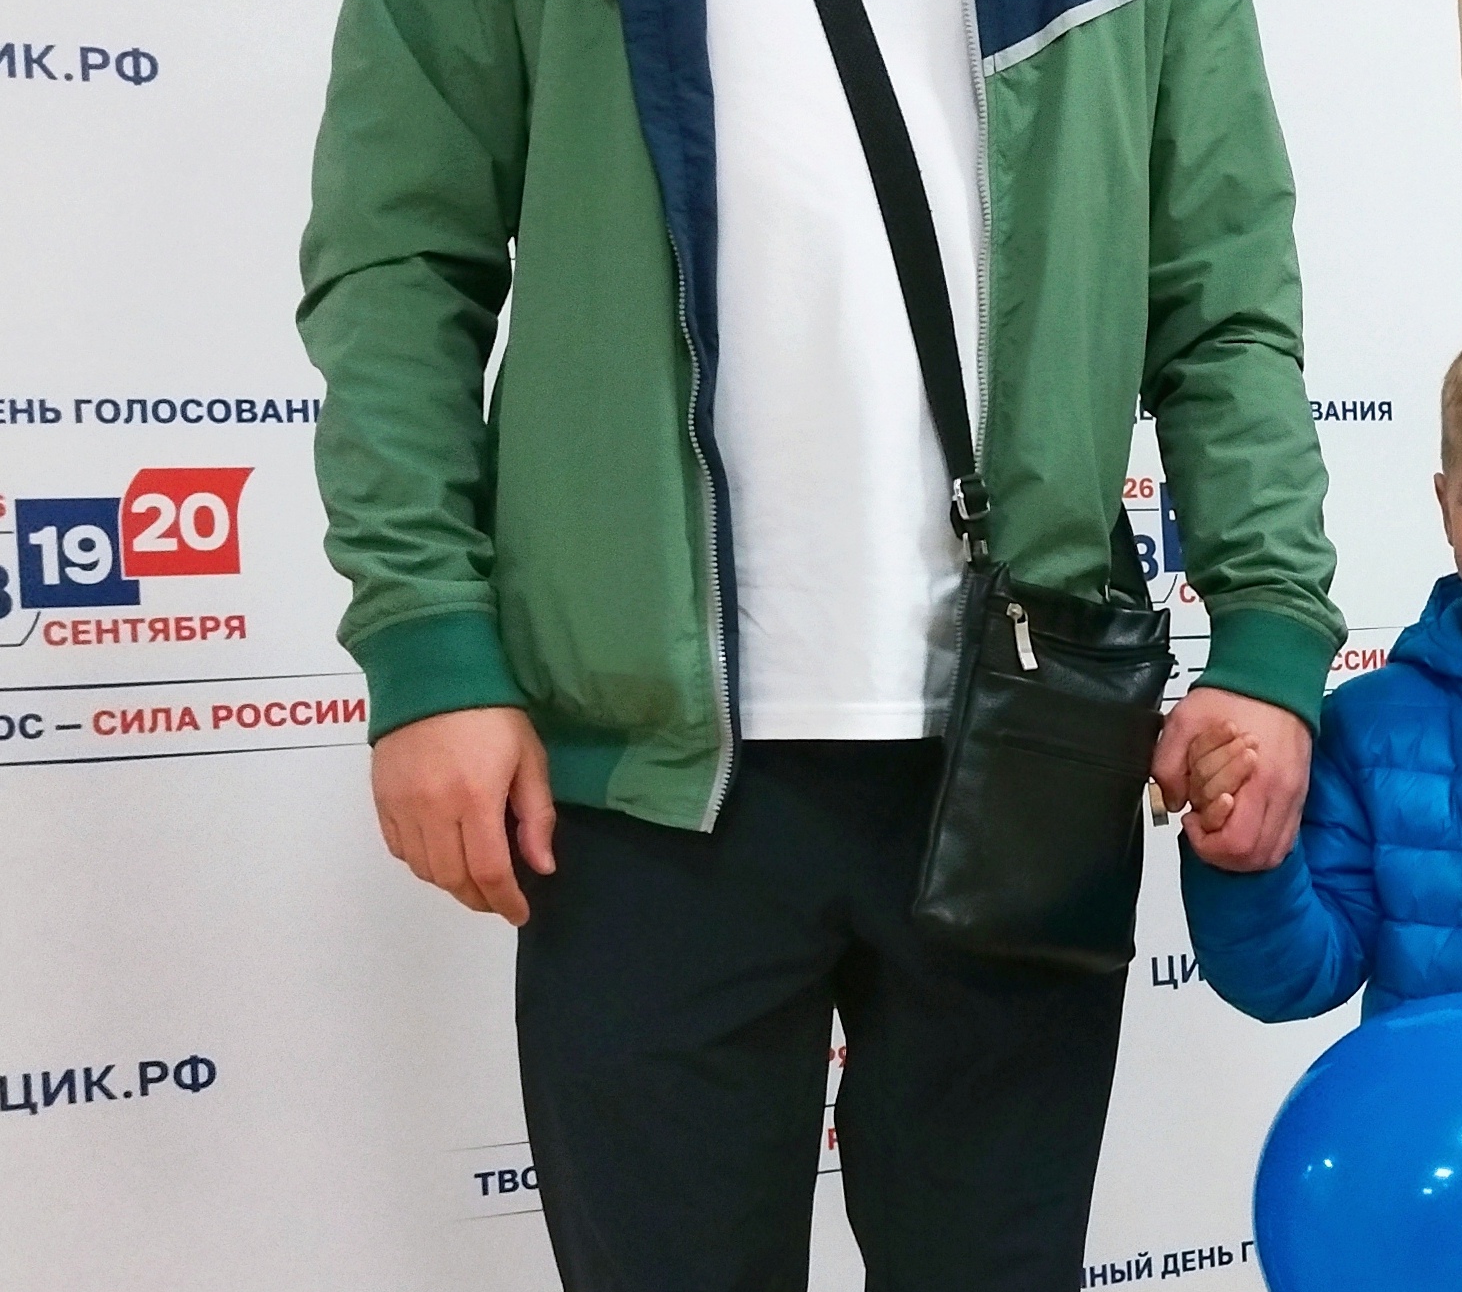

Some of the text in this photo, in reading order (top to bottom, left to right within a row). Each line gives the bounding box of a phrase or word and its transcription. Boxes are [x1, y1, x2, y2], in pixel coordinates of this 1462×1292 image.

[0, 42, 159, 86] К.РФ
[74, 398, 320, 425] ГОЛОСОВАН
[1310, 401, 1393, 422] ВАНИЯ
[1123, 478, 1154, 499] 26
[29, 492, 230, 586] 19 20
[43, 615, 247, 647] СЕНТЯБРЯ
[92, 707, 200, 736] СИЛА
[212, 698, 366, 730] РОССИИ
[1151, 954, 1204, 990] ЦИ
[0, 1054, 217, 1116] ЦИК.РФ
[474, 1165, 539, 1196] ТВО
[1081, 1251, 1152, 1289] НЫЙ
[1161, 1246, 1233, 1279] ДЕНЬ
